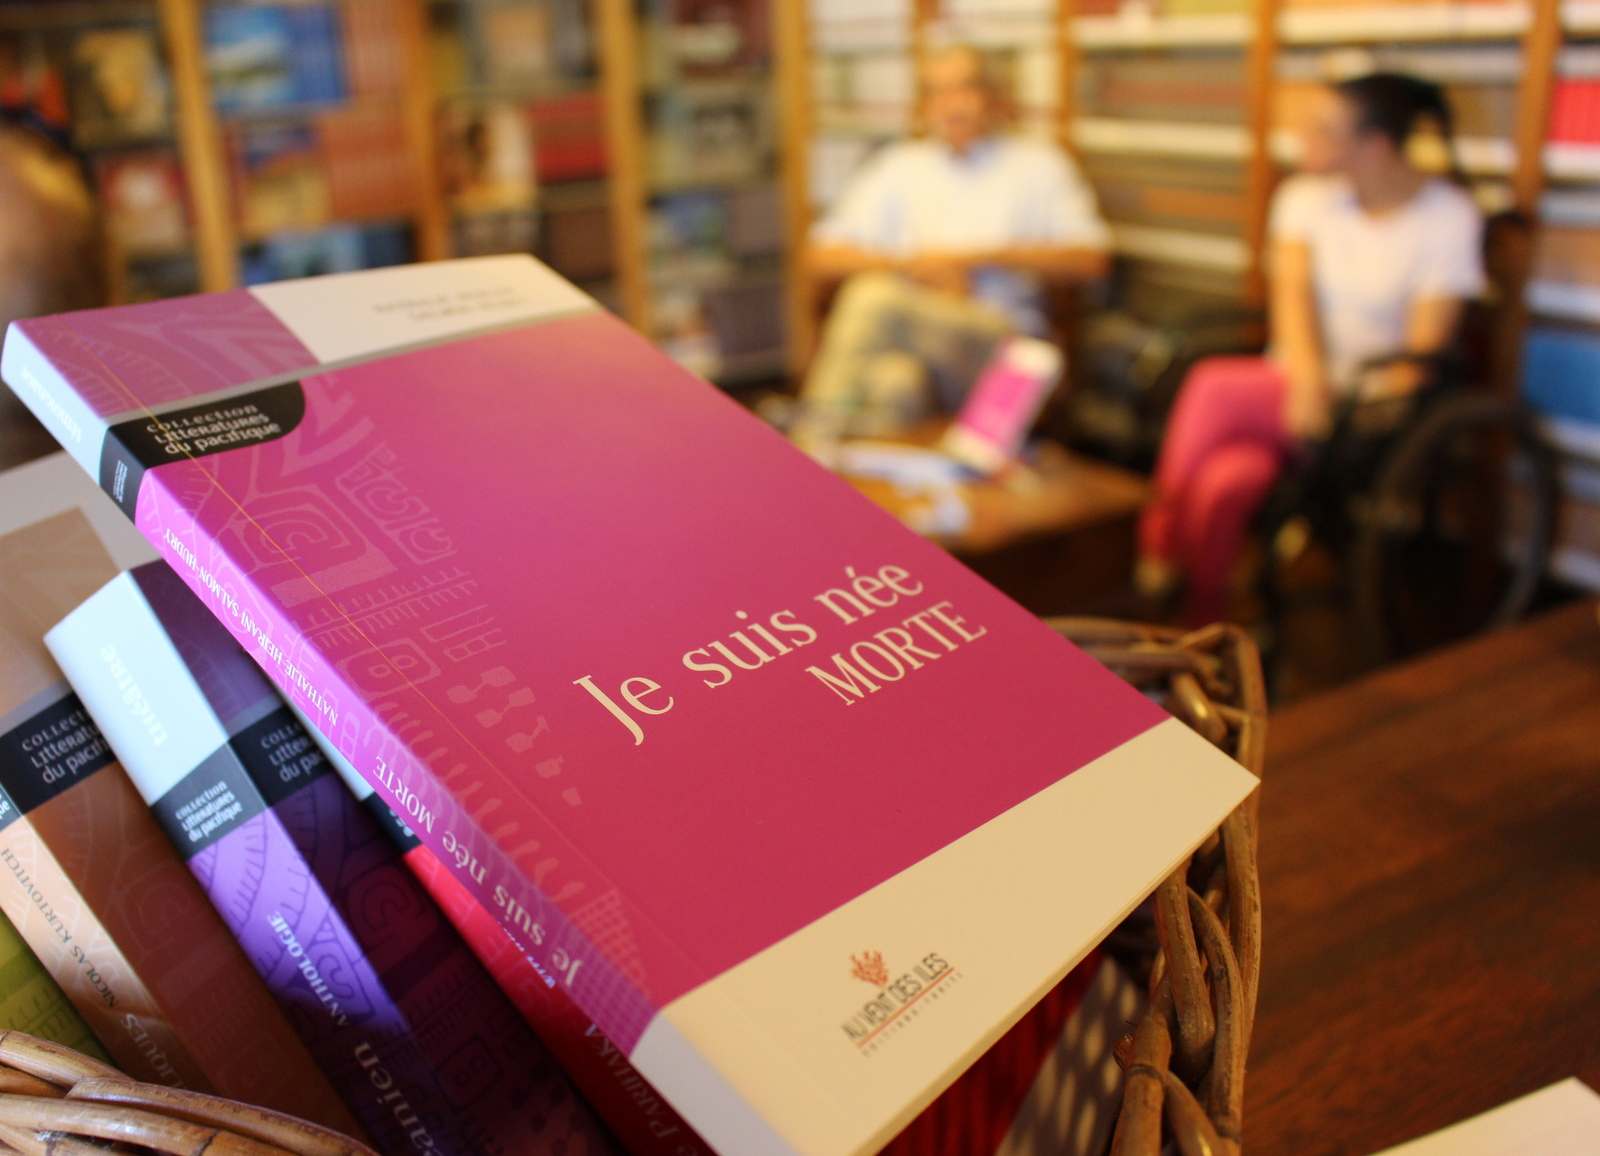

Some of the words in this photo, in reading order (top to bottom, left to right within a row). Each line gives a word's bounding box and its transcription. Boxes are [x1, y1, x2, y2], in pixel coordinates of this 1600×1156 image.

[164, 442, 192, 455] du
[194, 423, 281, 452] pacifique
[163, 527, 241, 617] SALMON-HUDRY
[240, 614, 284, 665] HEIRANI
[572, 674, 674, 746] Je
[682, 610, 817, 689] suis
[813, 565, 923, 625] née
[805, 600, 988, 706] MORTE
[285, 659, 339, 727] NATHALIE
[42, 764, 65, 784] du
[279, 763, 300, 782] du
[372, 756, 436, 834] MORTE
[188, 828, 203, 842] du
[200, 801, 243, 837] pacifique
[442, 831, 487, 886] née
[0, 847, 72, 944] KURTOVITCH
[493, 884, 546, 946] suis
[70, 945, 116, 1007] NICOLAS
[267, 911, 350, 1027] ANTHOLOGIE
[552, 947, 582, 986] Je
[858, 991, 897, 1026] VENT
[887, 973, 922, 1004] DES
[584, 1022, 680, 1139] PARIHAKA
